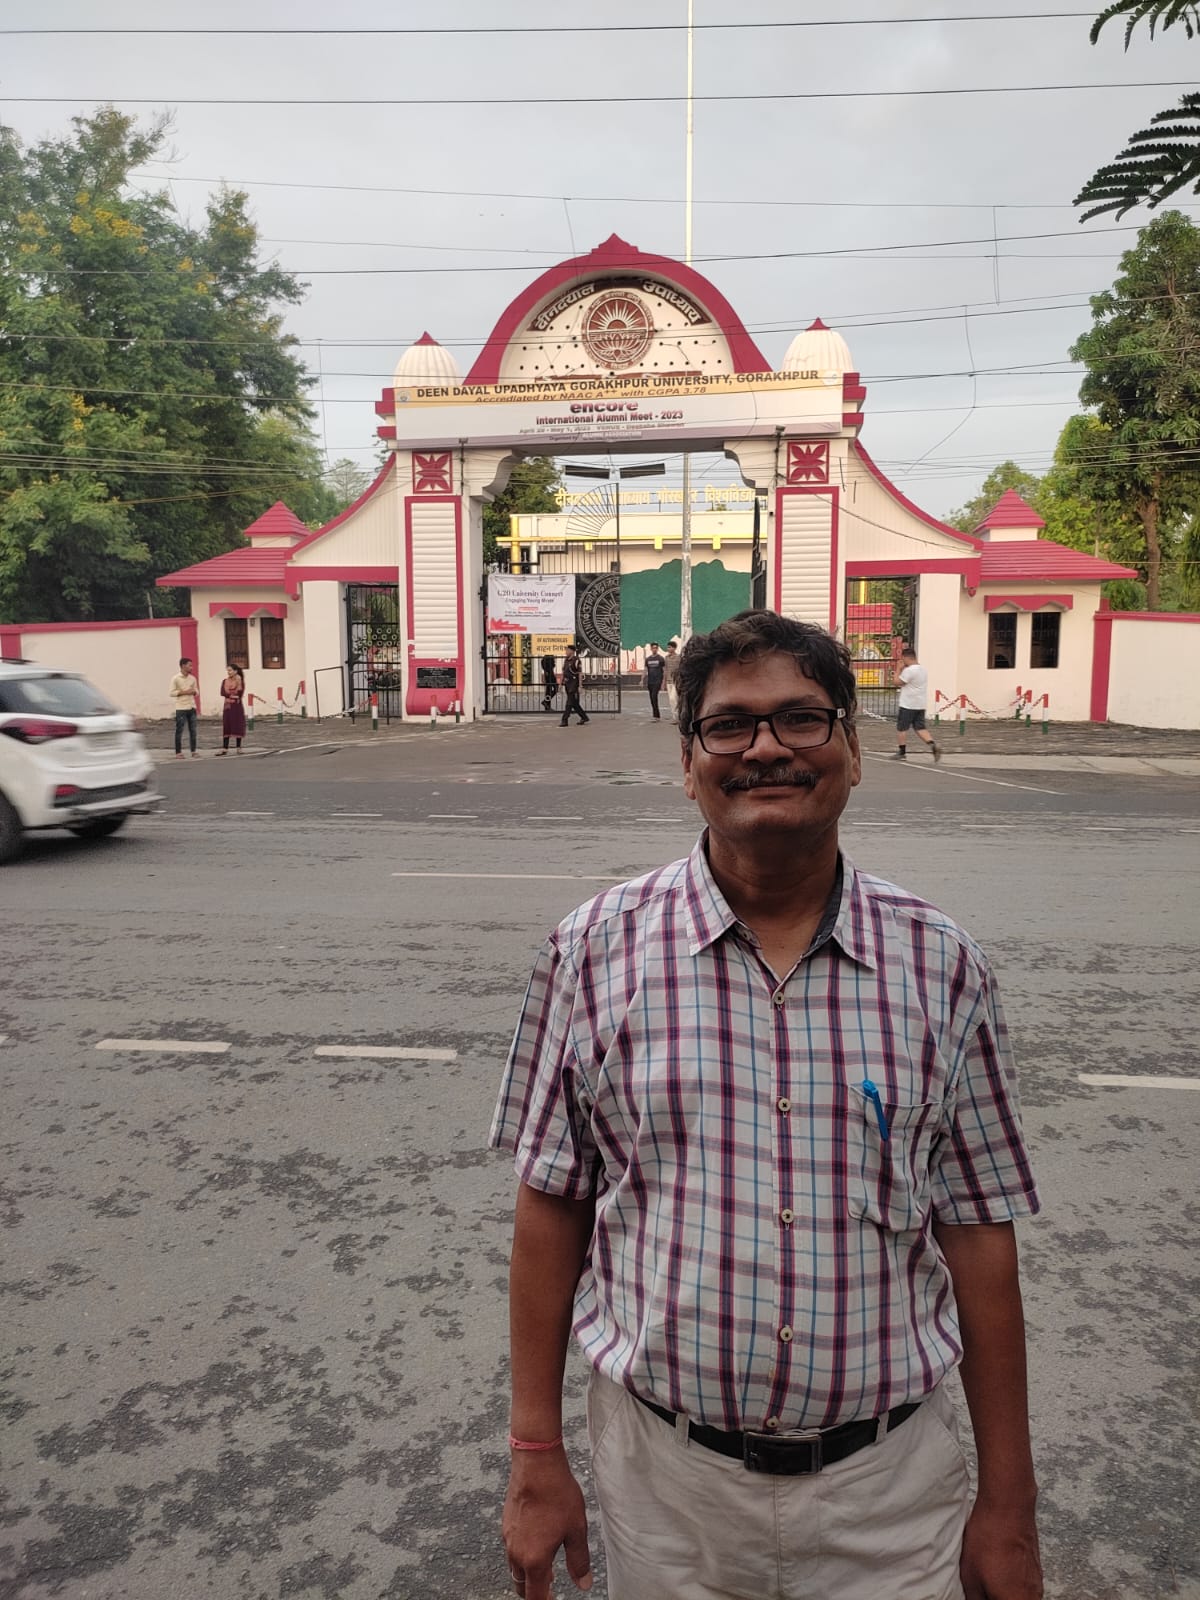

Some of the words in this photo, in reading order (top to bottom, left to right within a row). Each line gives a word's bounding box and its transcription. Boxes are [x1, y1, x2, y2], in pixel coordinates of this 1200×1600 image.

[642, 281, 702, 323] उपाध्याय
[417, 387, 449, 397] DEEN
[453, 385, 490, 396] DAYAL
[494, 383, 566, 394] UPADHYAYA
[570, 379, 649, 390] GORAKHPUR
[653, 374, 733, 388] UNIVERSITY,
[736, 370, 819, 383] GORAKHPUR
[542, 393, 557, 401] by
[560, 391, 592, 399] NAAC
[620, 389, 644, 397] with
[647, 387, 680, 396] CGPA
[570, 401, 639, 413] encore
[536, 413, 594, 425] International
[596, 412, 628, 422] Alumni
[630, 412, 653, 421] Meet
[661, 410, 684, 419] 2023
